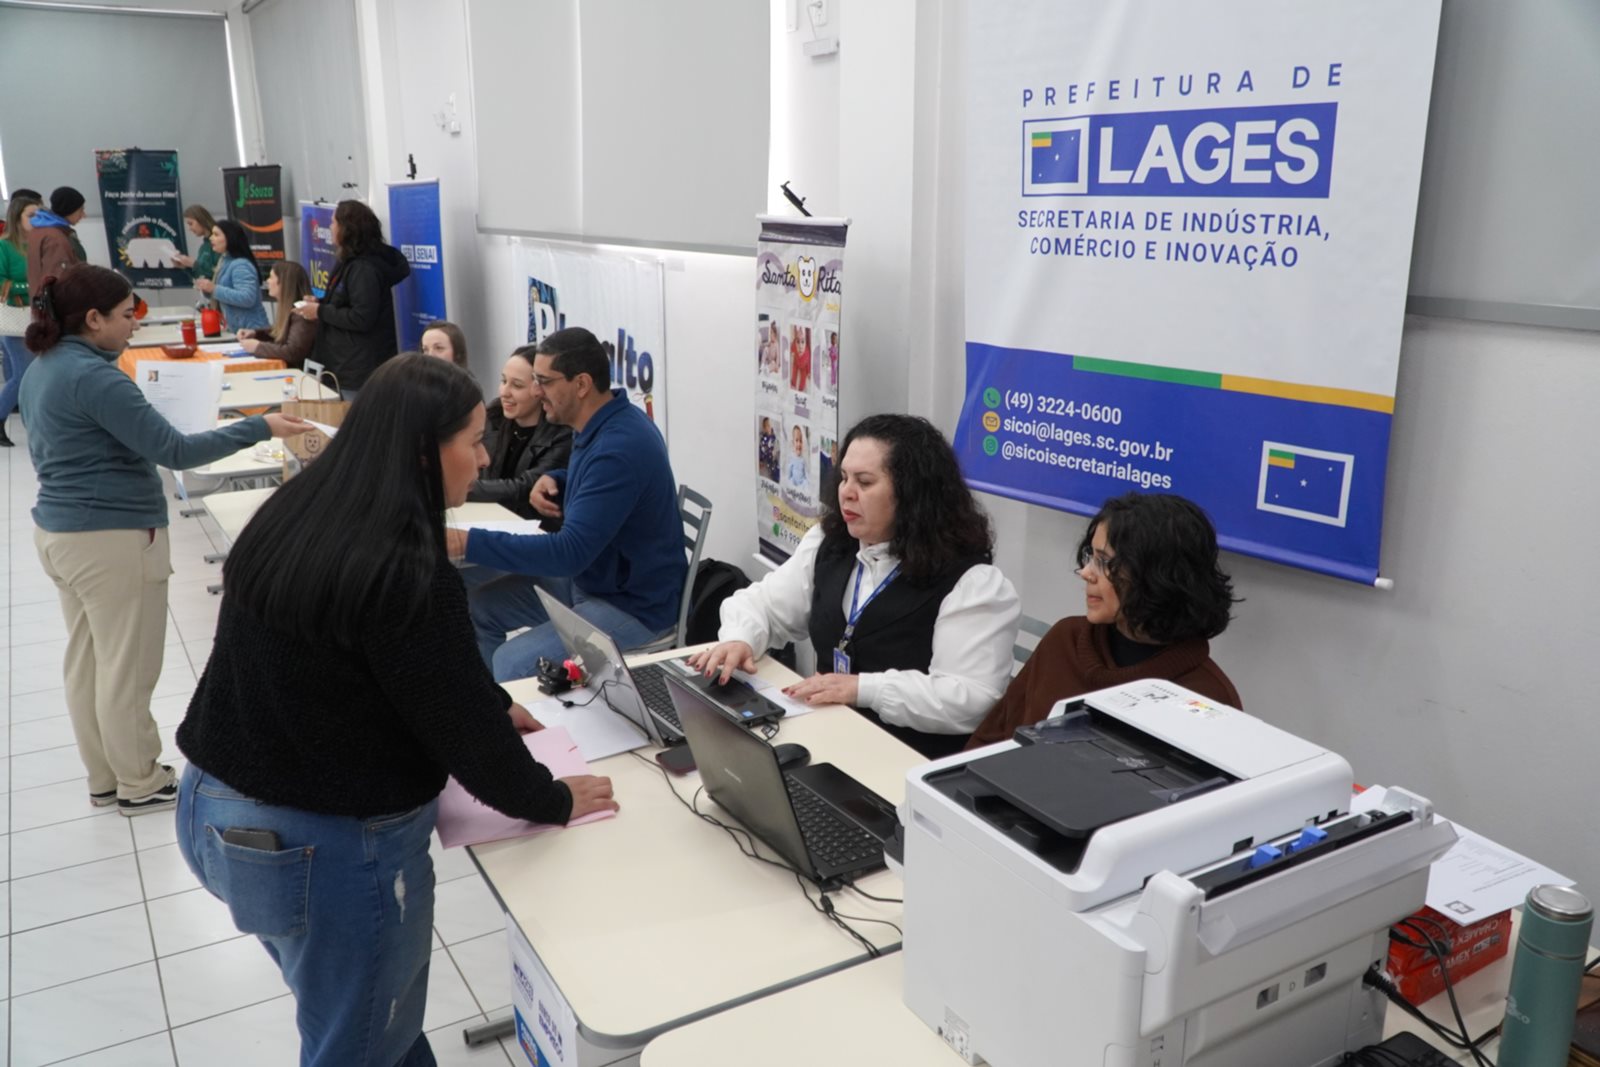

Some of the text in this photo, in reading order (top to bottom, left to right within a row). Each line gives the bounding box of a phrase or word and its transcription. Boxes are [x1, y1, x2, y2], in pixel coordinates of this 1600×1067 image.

[1023, 62, 1343, 108] PREFEITURA DE
[1098, 117, 1321, 186] LAGES
[1017, 208, 1331, 241] SECRETARIA DE INDÚSTRIA,
[416, 247, 435, 261] SENAI
[1030, 234, 1299, 272] COMÉRCIO E INOVAÇÃO
[762, 259, 842, 296] Santa Rita
[1004, 389, 1122, 426] (49) 3224-0600
[1003, 416, 1174, 463] sicoi@lages.sc.gov.br
[1001, 440, 1172, 490] @sicoisecretarialages
